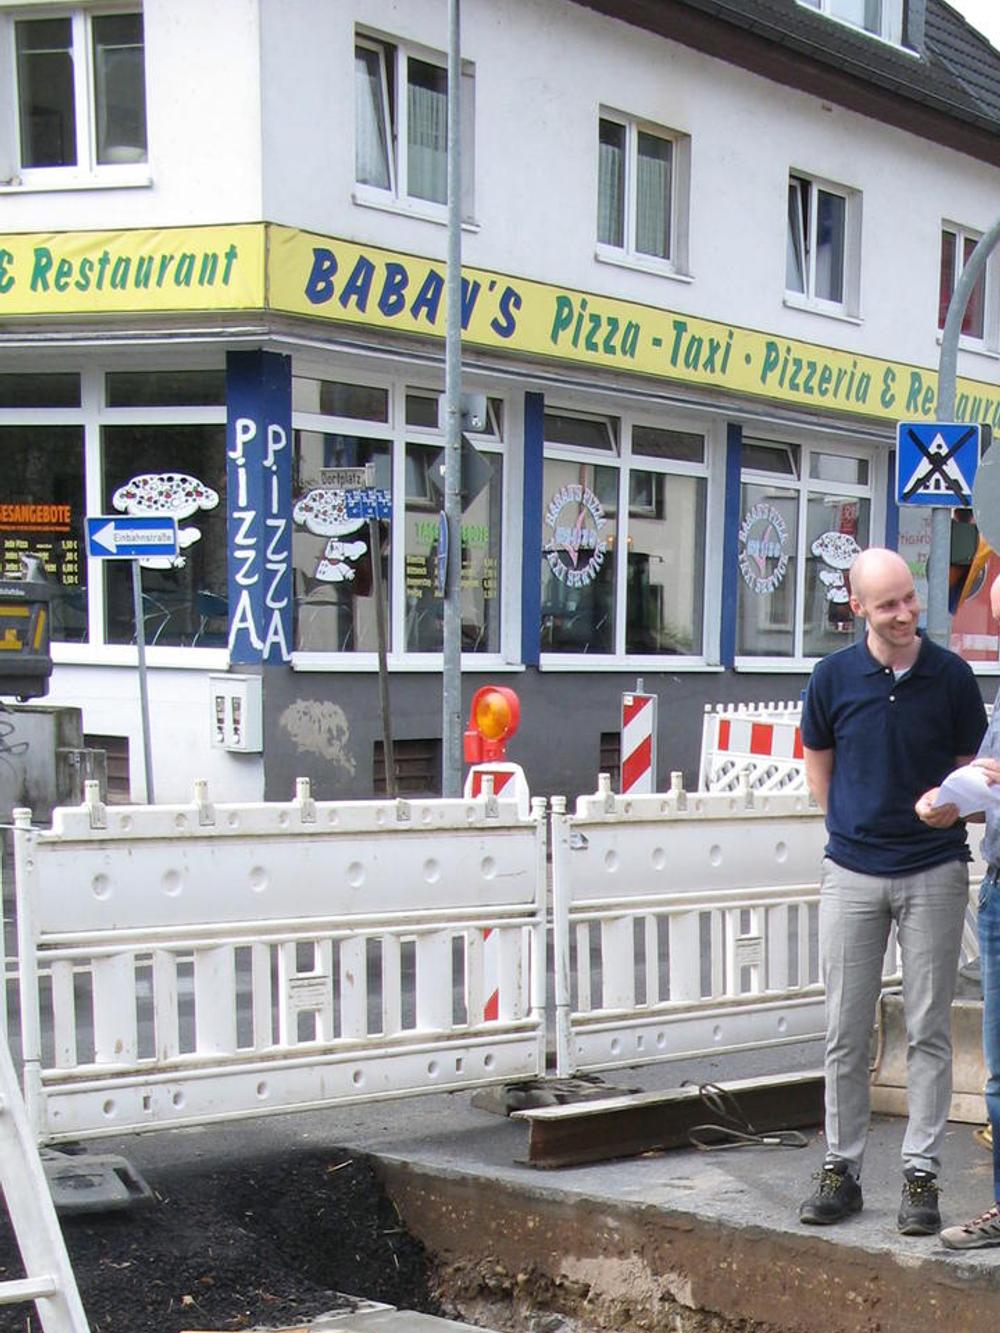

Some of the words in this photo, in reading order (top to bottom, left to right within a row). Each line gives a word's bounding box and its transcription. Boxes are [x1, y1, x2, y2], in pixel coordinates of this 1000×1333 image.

[30, 243, 238, 292] Restaurant
[551, 295, 640, 359] Pizza
[670, 320, 734, 375] Taxi
[760, 341, 871, 404] Pizzeria
[114, 531, 172, 543] Einbahnstraße
